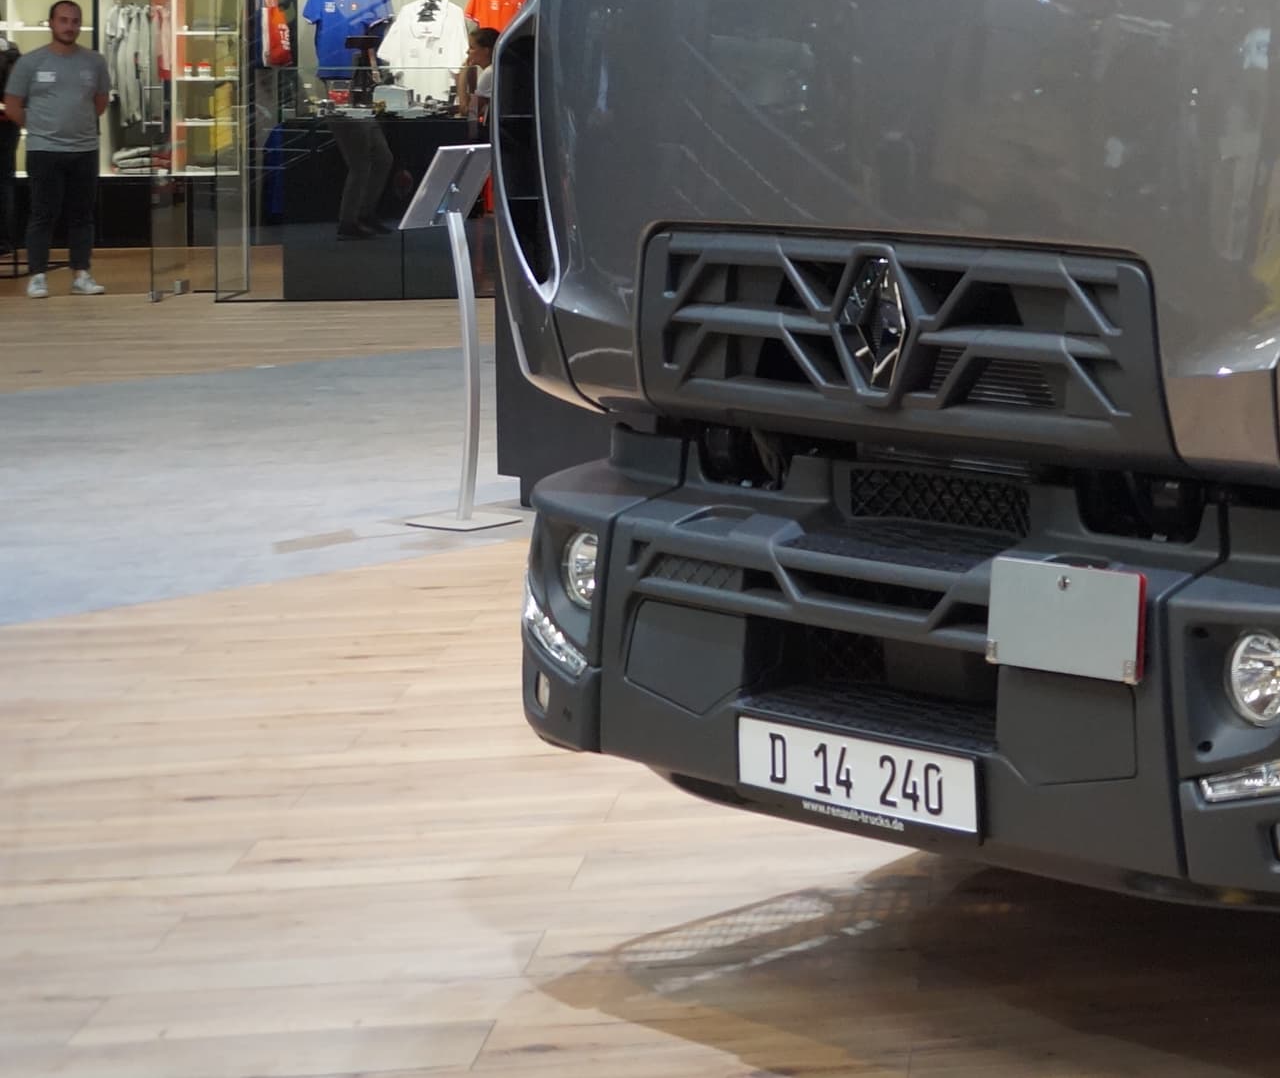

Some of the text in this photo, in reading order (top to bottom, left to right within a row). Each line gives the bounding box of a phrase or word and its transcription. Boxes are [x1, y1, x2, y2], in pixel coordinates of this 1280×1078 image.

[769, 732, 944, 816] D 14 240
[802, 799, 905, 832] www.renault-trucks.de
